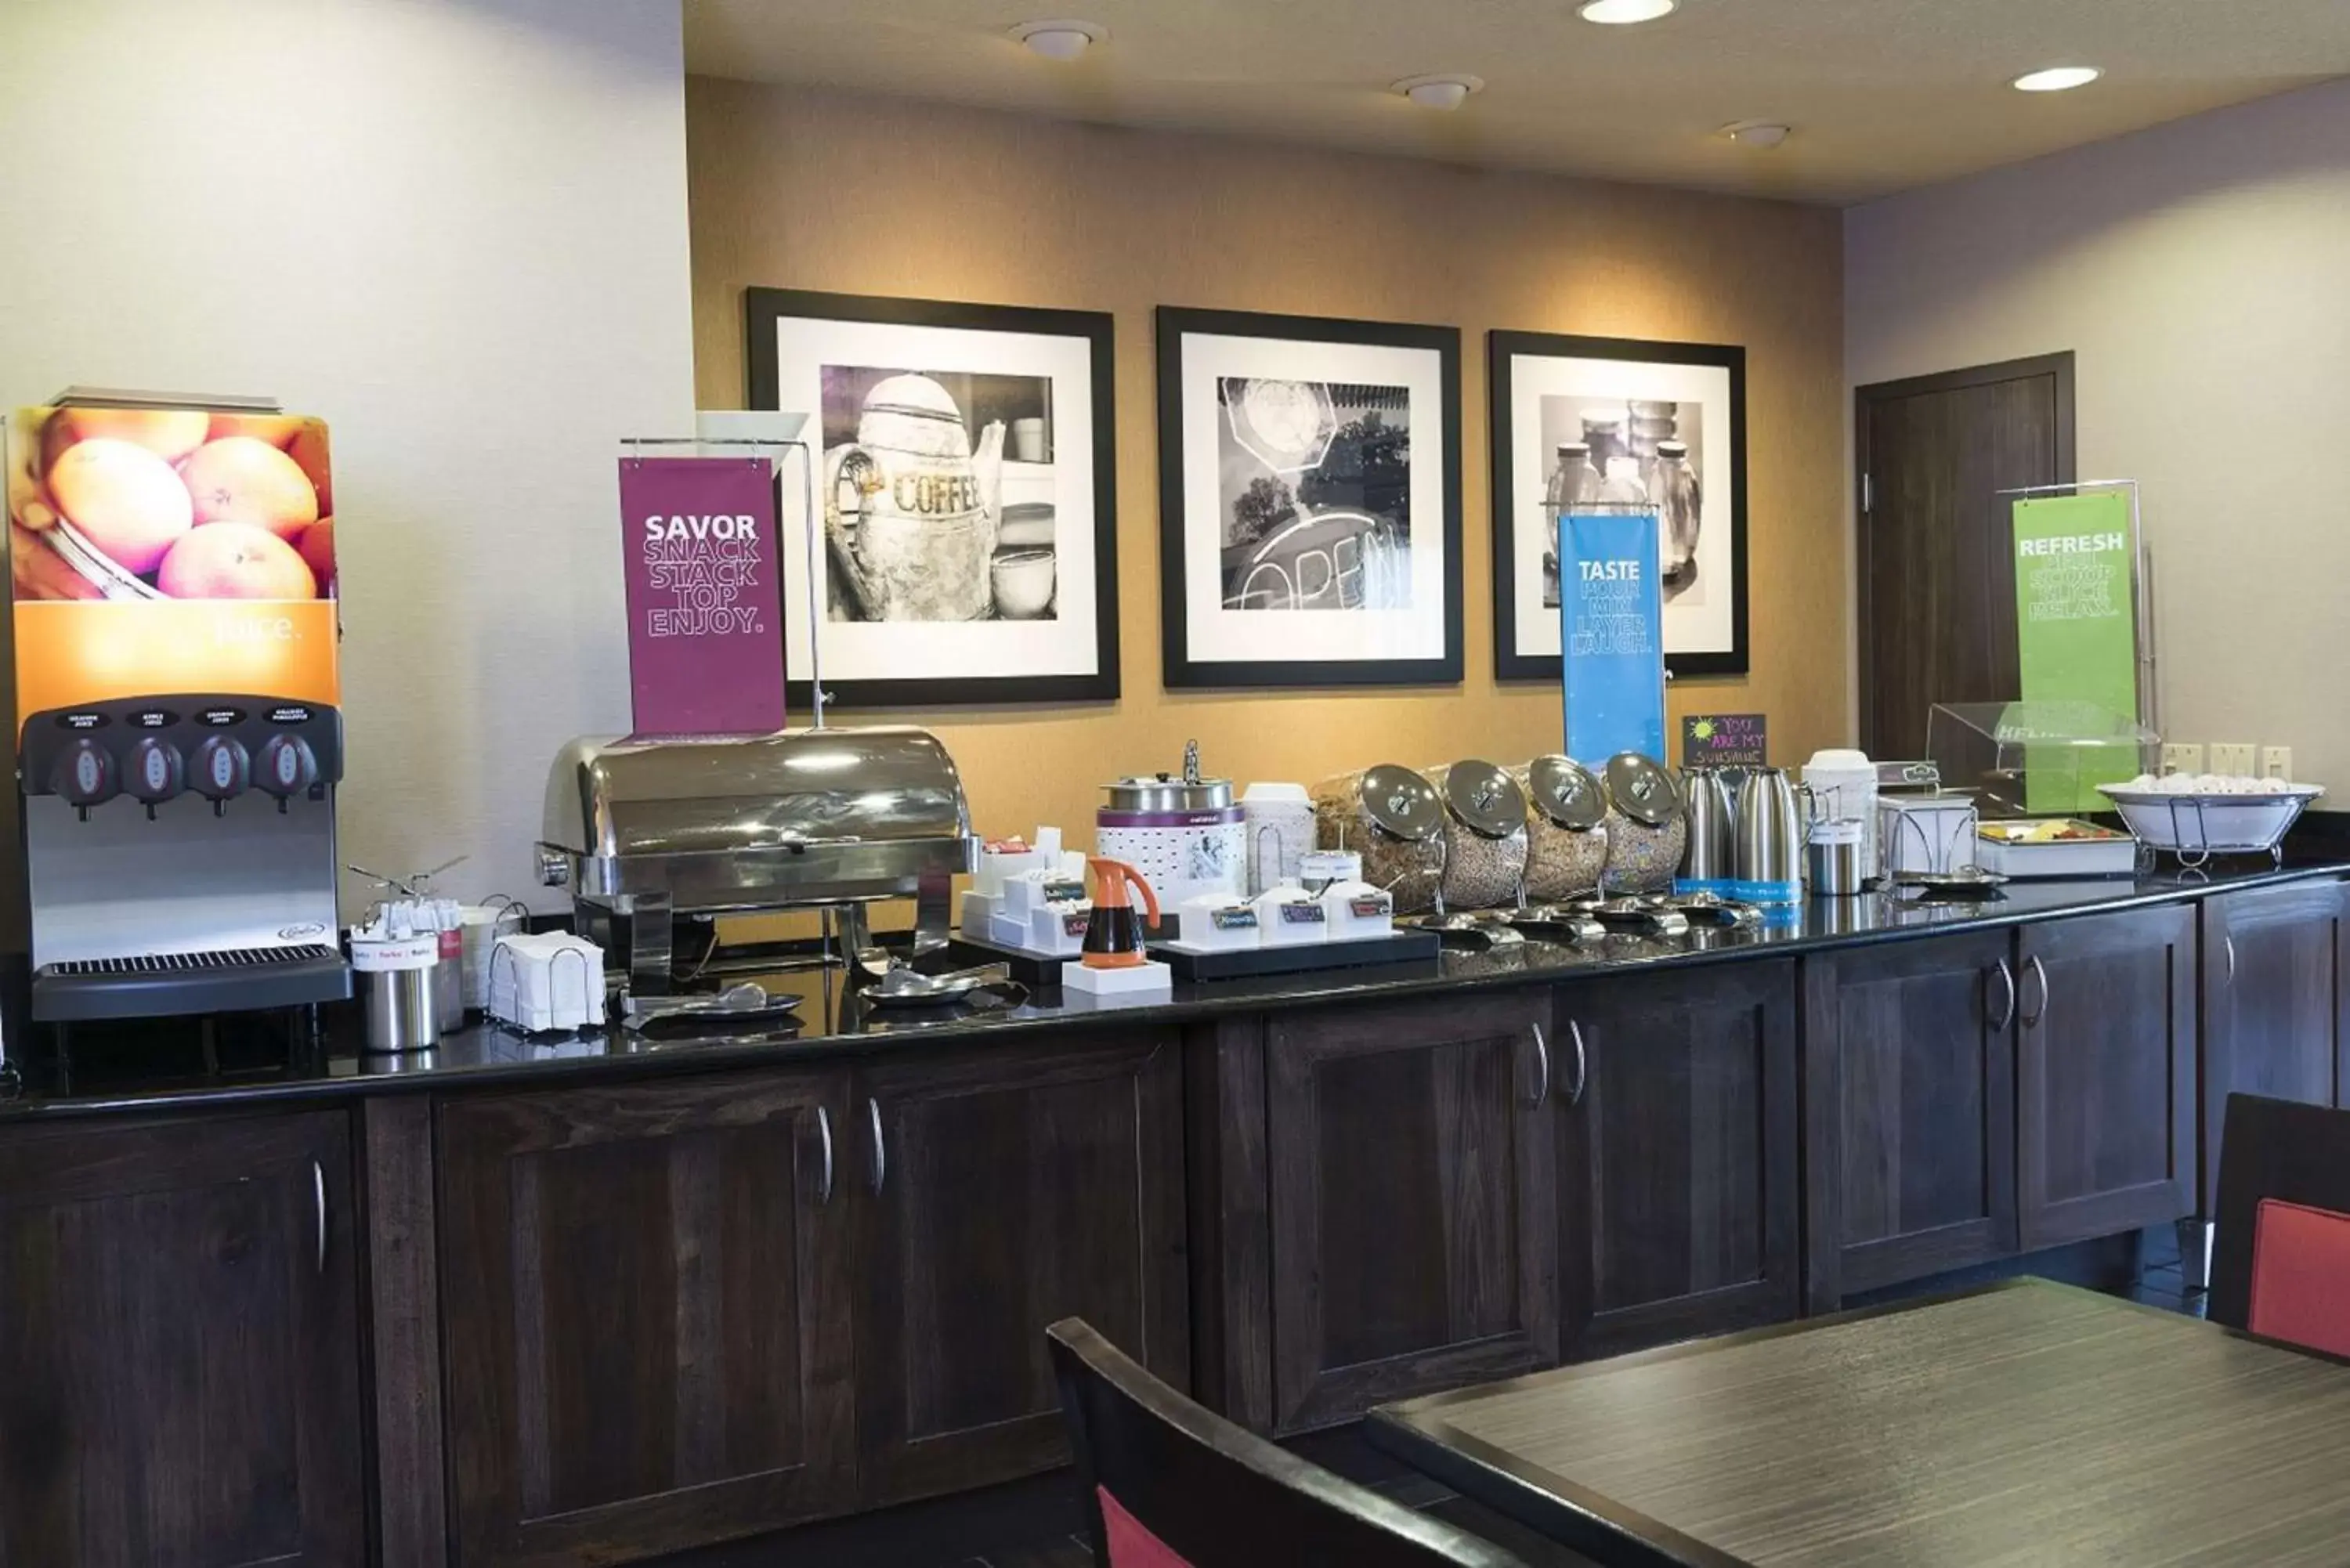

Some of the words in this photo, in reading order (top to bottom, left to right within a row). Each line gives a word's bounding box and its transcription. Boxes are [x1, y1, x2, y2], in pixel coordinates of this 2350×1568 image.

[645, 515, 756, 540] SAVOR
[644, 538, 761, 563] SNACK
[2019, 532, 2124, 557] REFRESH
[649, 560, 758, 588] STACK
[1578, 560, 1640, 580] TASTE
[671, 584, 739, 611] TOP
[648, 609, 765, 637] ENJOY.
[1723, 717, 1752, 735] YOU
[1710, 735, 1740, 749] ARE
[1742, 734, 1764, 748] MY
[1694, 750, 1761, 764] SUNSHINE
